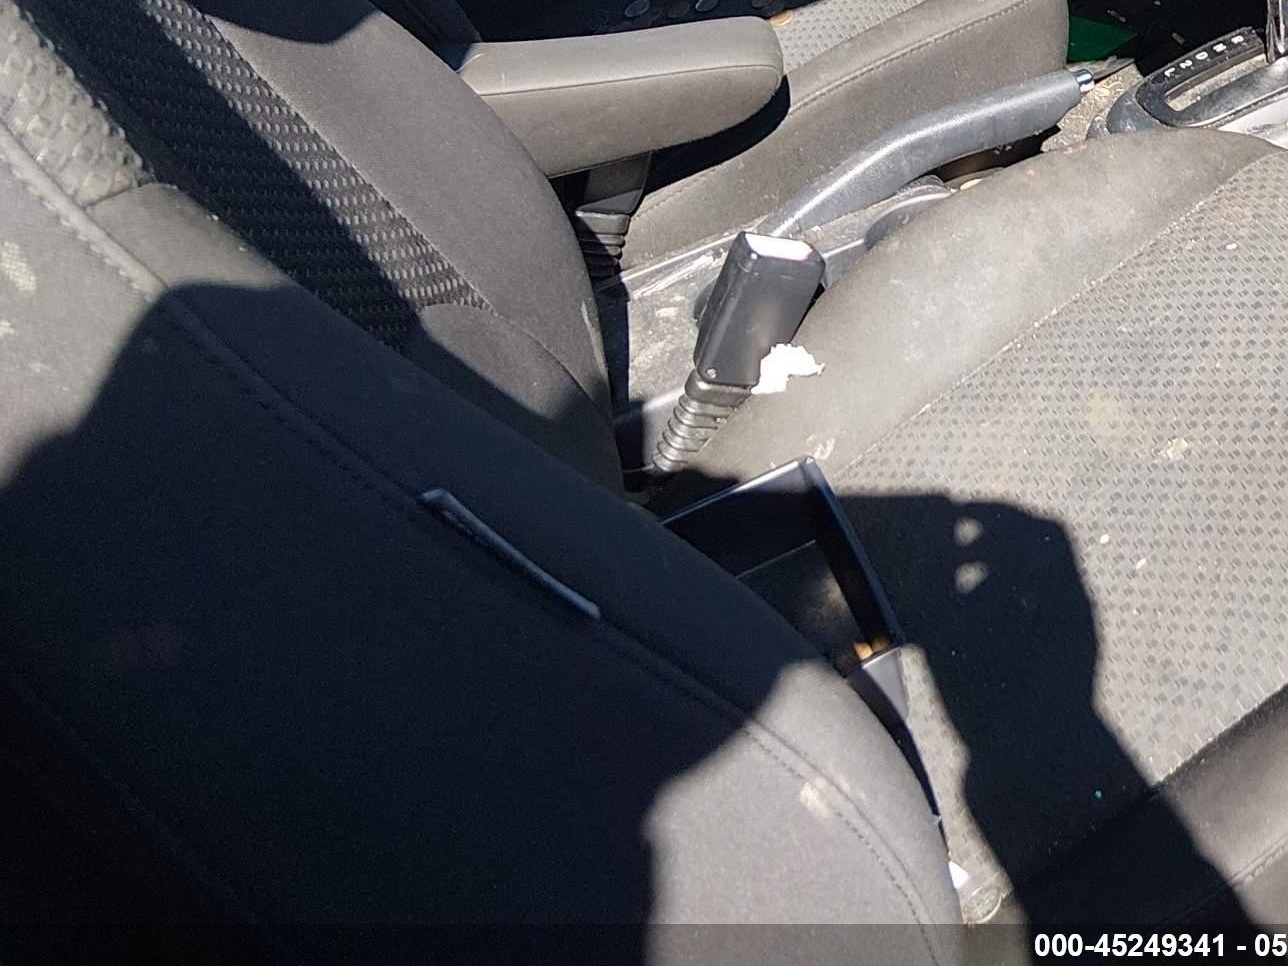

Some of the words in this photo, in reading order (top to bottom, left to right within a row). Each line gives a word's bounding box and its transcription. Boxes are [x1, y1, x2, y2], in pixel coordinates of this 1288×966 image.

[1195, 51, 1209, 60] D
[1180, 59, 1193, 69] 2
[1164, 67, 1176, 78] L
